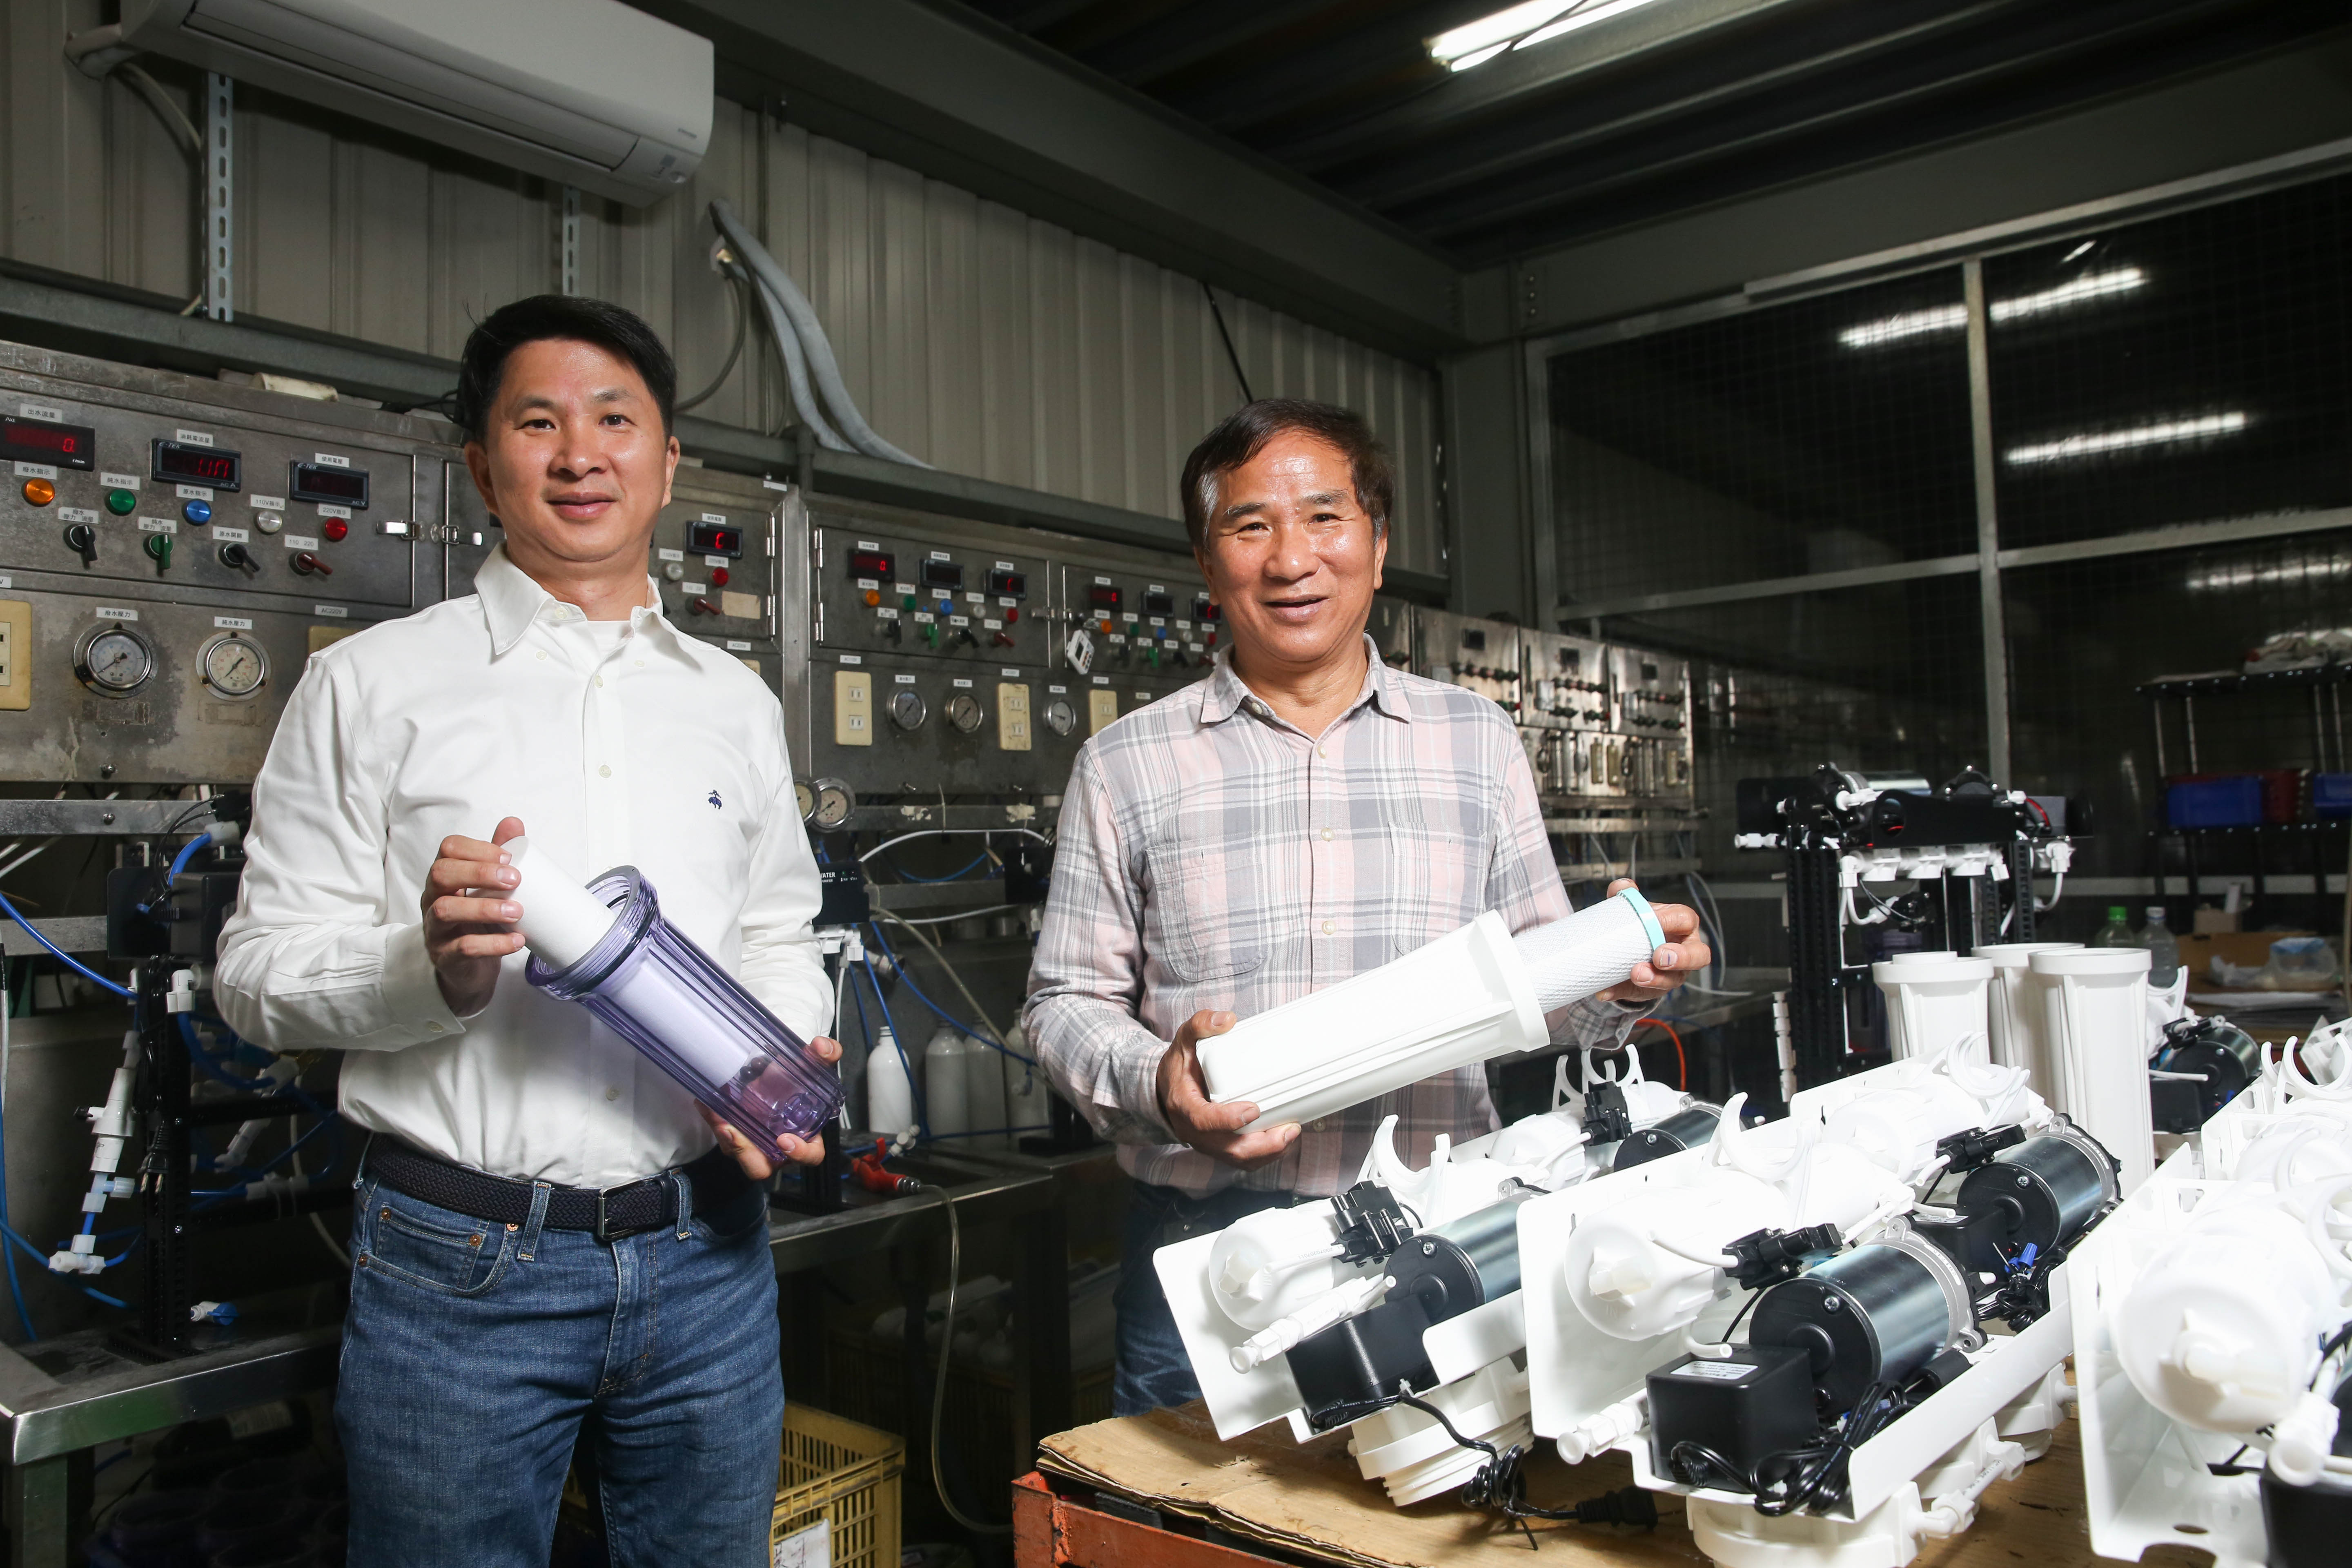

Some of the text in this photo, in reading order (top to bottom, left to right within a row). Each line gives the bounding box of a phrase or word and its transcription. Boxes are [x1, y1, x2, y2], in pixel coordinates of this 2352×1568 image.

[28, 409, 55, 419] 出水流量
[180, 434, 210, 443] 消耗電流量
[22, 466, 50, 475] 廢水指示
[107, 477, 133, 485] 純水指示
[183, 488, 207, 497] 原水指示
[323, 507, 347, 515] 220V指示
